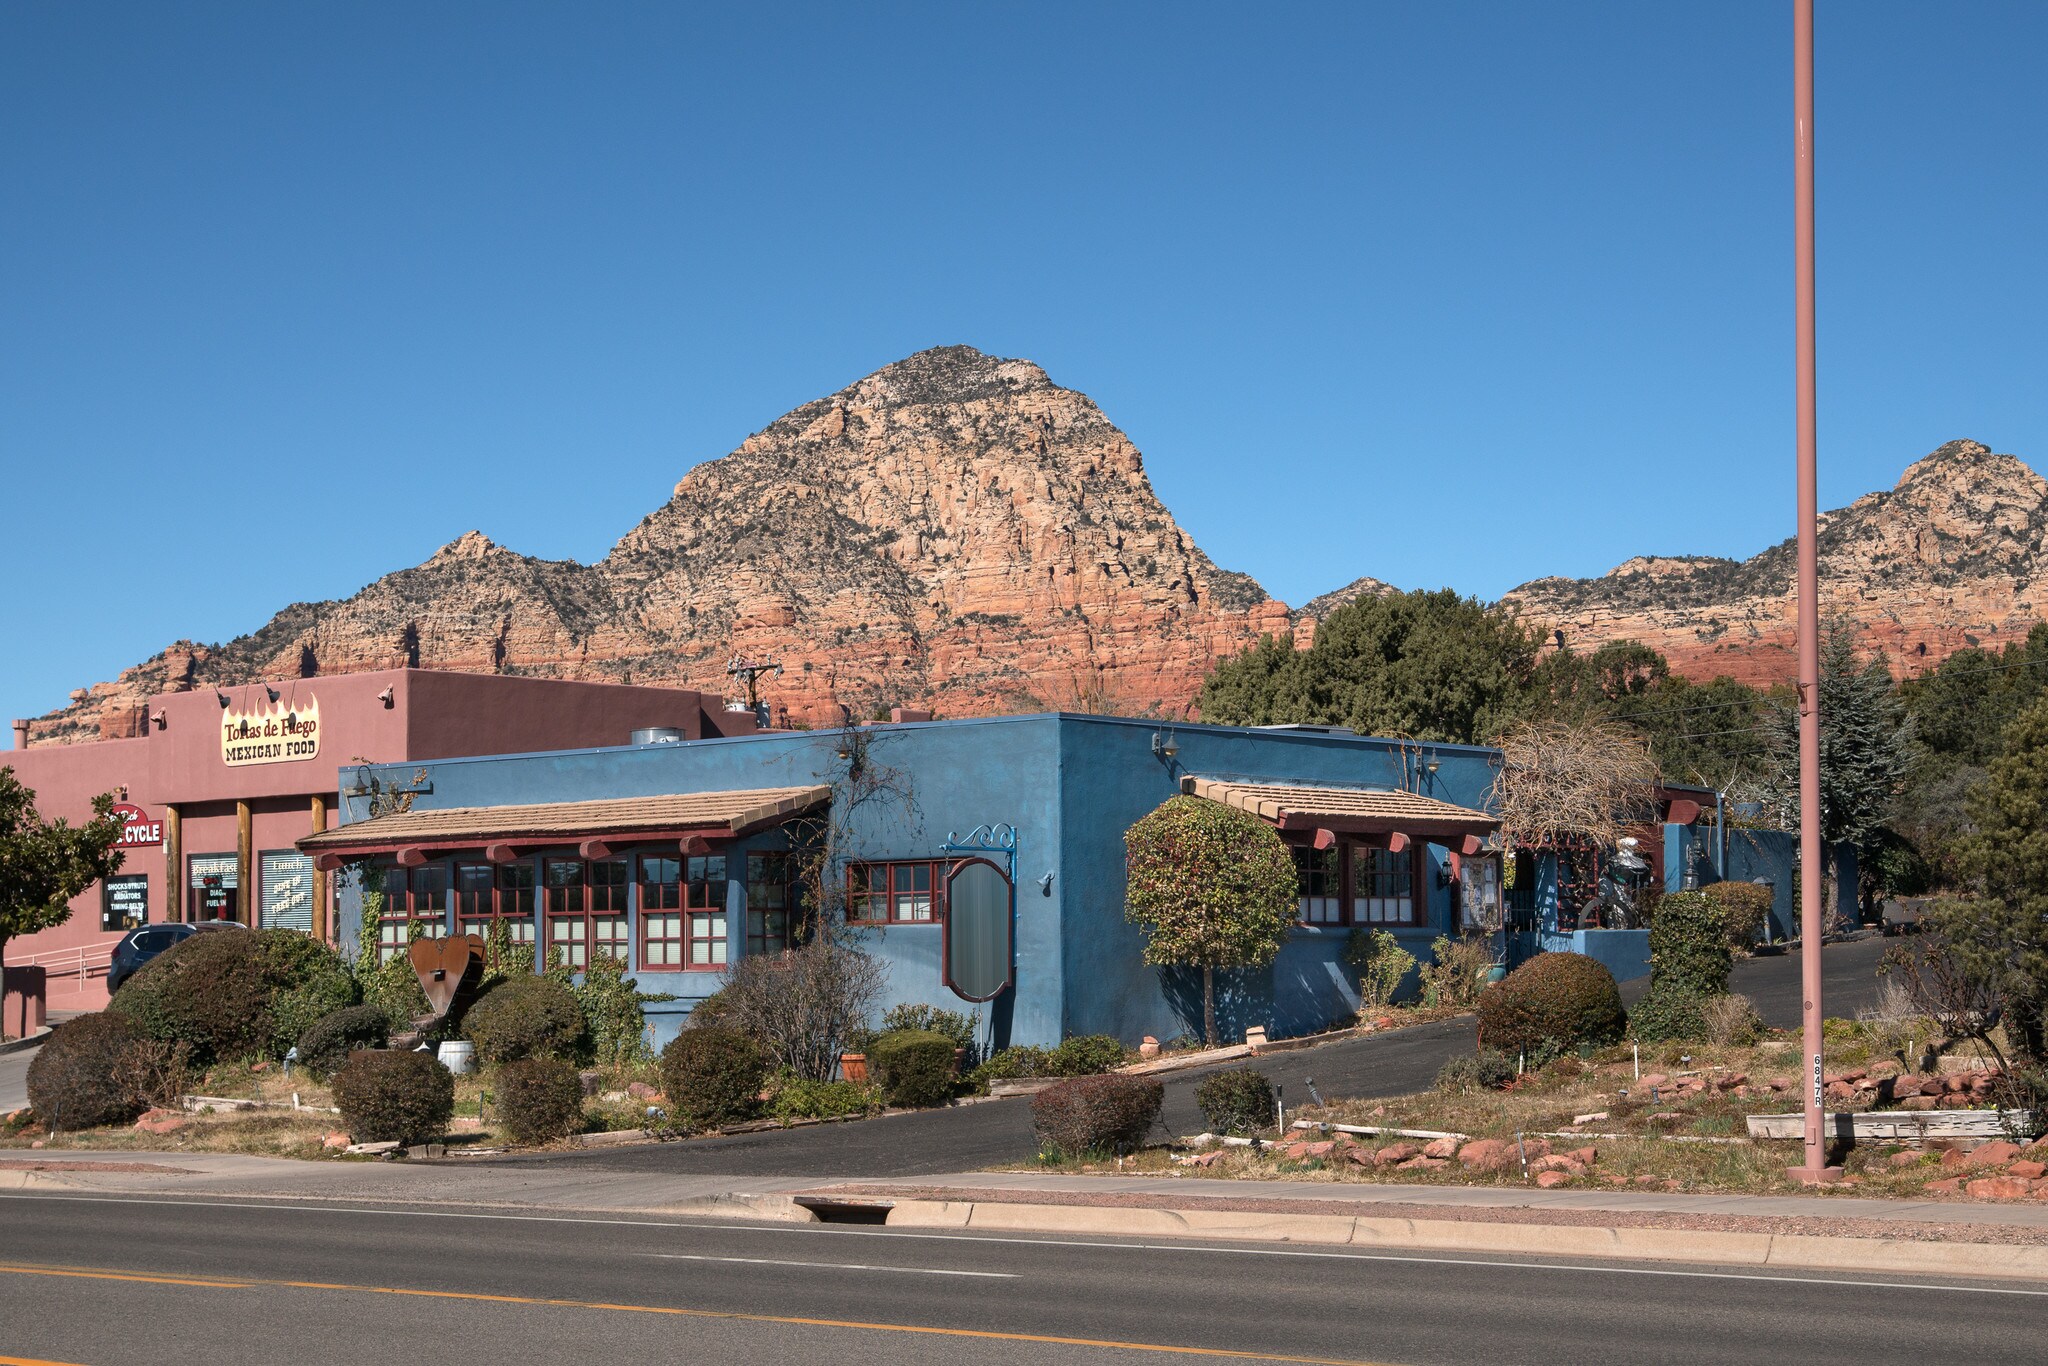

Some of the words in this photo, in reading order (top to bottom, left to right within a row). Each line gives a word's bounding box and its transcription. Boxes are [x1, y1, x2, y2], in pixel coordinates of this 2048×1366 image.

[264, 718, 278, 737] de
[226, 743, 281, 761] MEXICAN
[286, 740, 315, 756] FOOD
[125, 824, 160, 843] CYCLE
[192, 862, 238, 873] Breakfast
[273, 857, 303, 869] Lunch
[206, 899, 219, 907] FUEL
